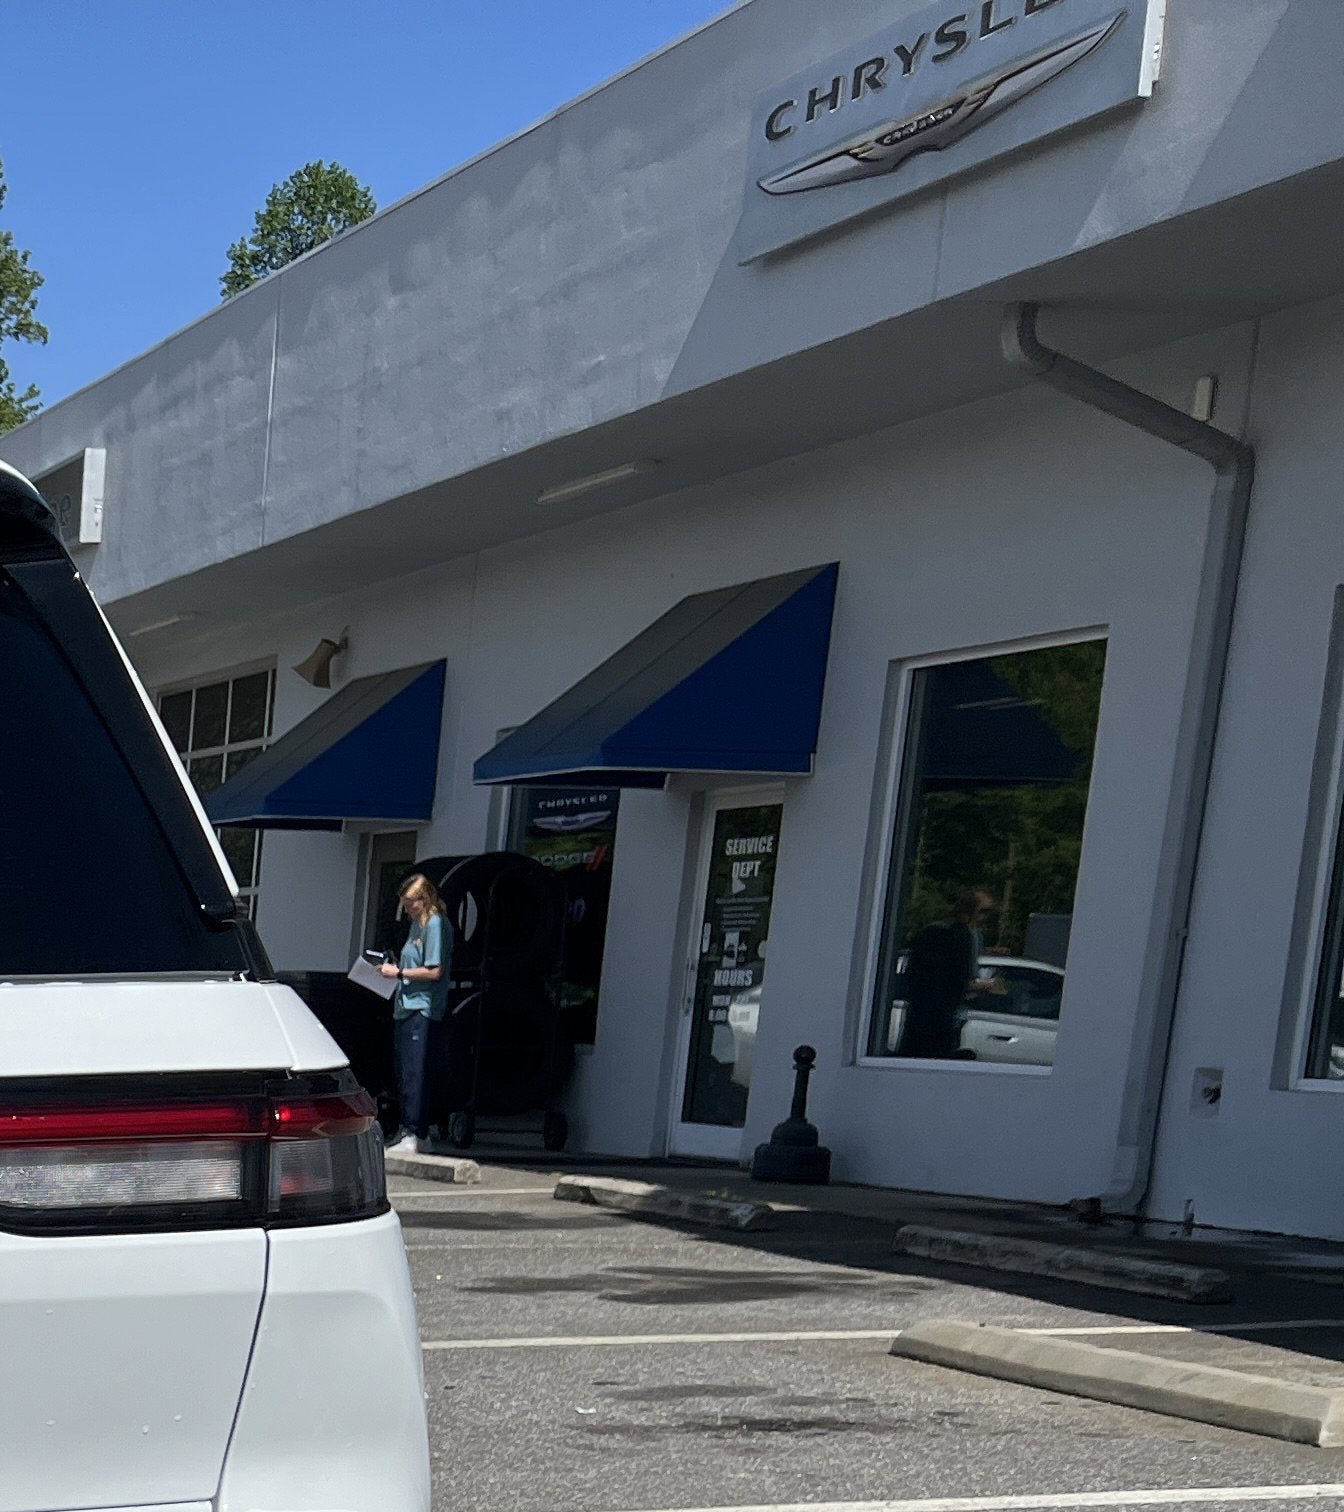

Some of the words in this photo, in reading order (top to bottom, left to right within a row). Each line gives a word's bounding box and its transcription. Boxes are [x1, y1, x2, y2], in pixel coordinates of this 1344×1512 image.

[725, 835, 775, 856] SERVICE
[732, 860, 761, 878] DEPT
[714, 968, 753, 987] HOURS
